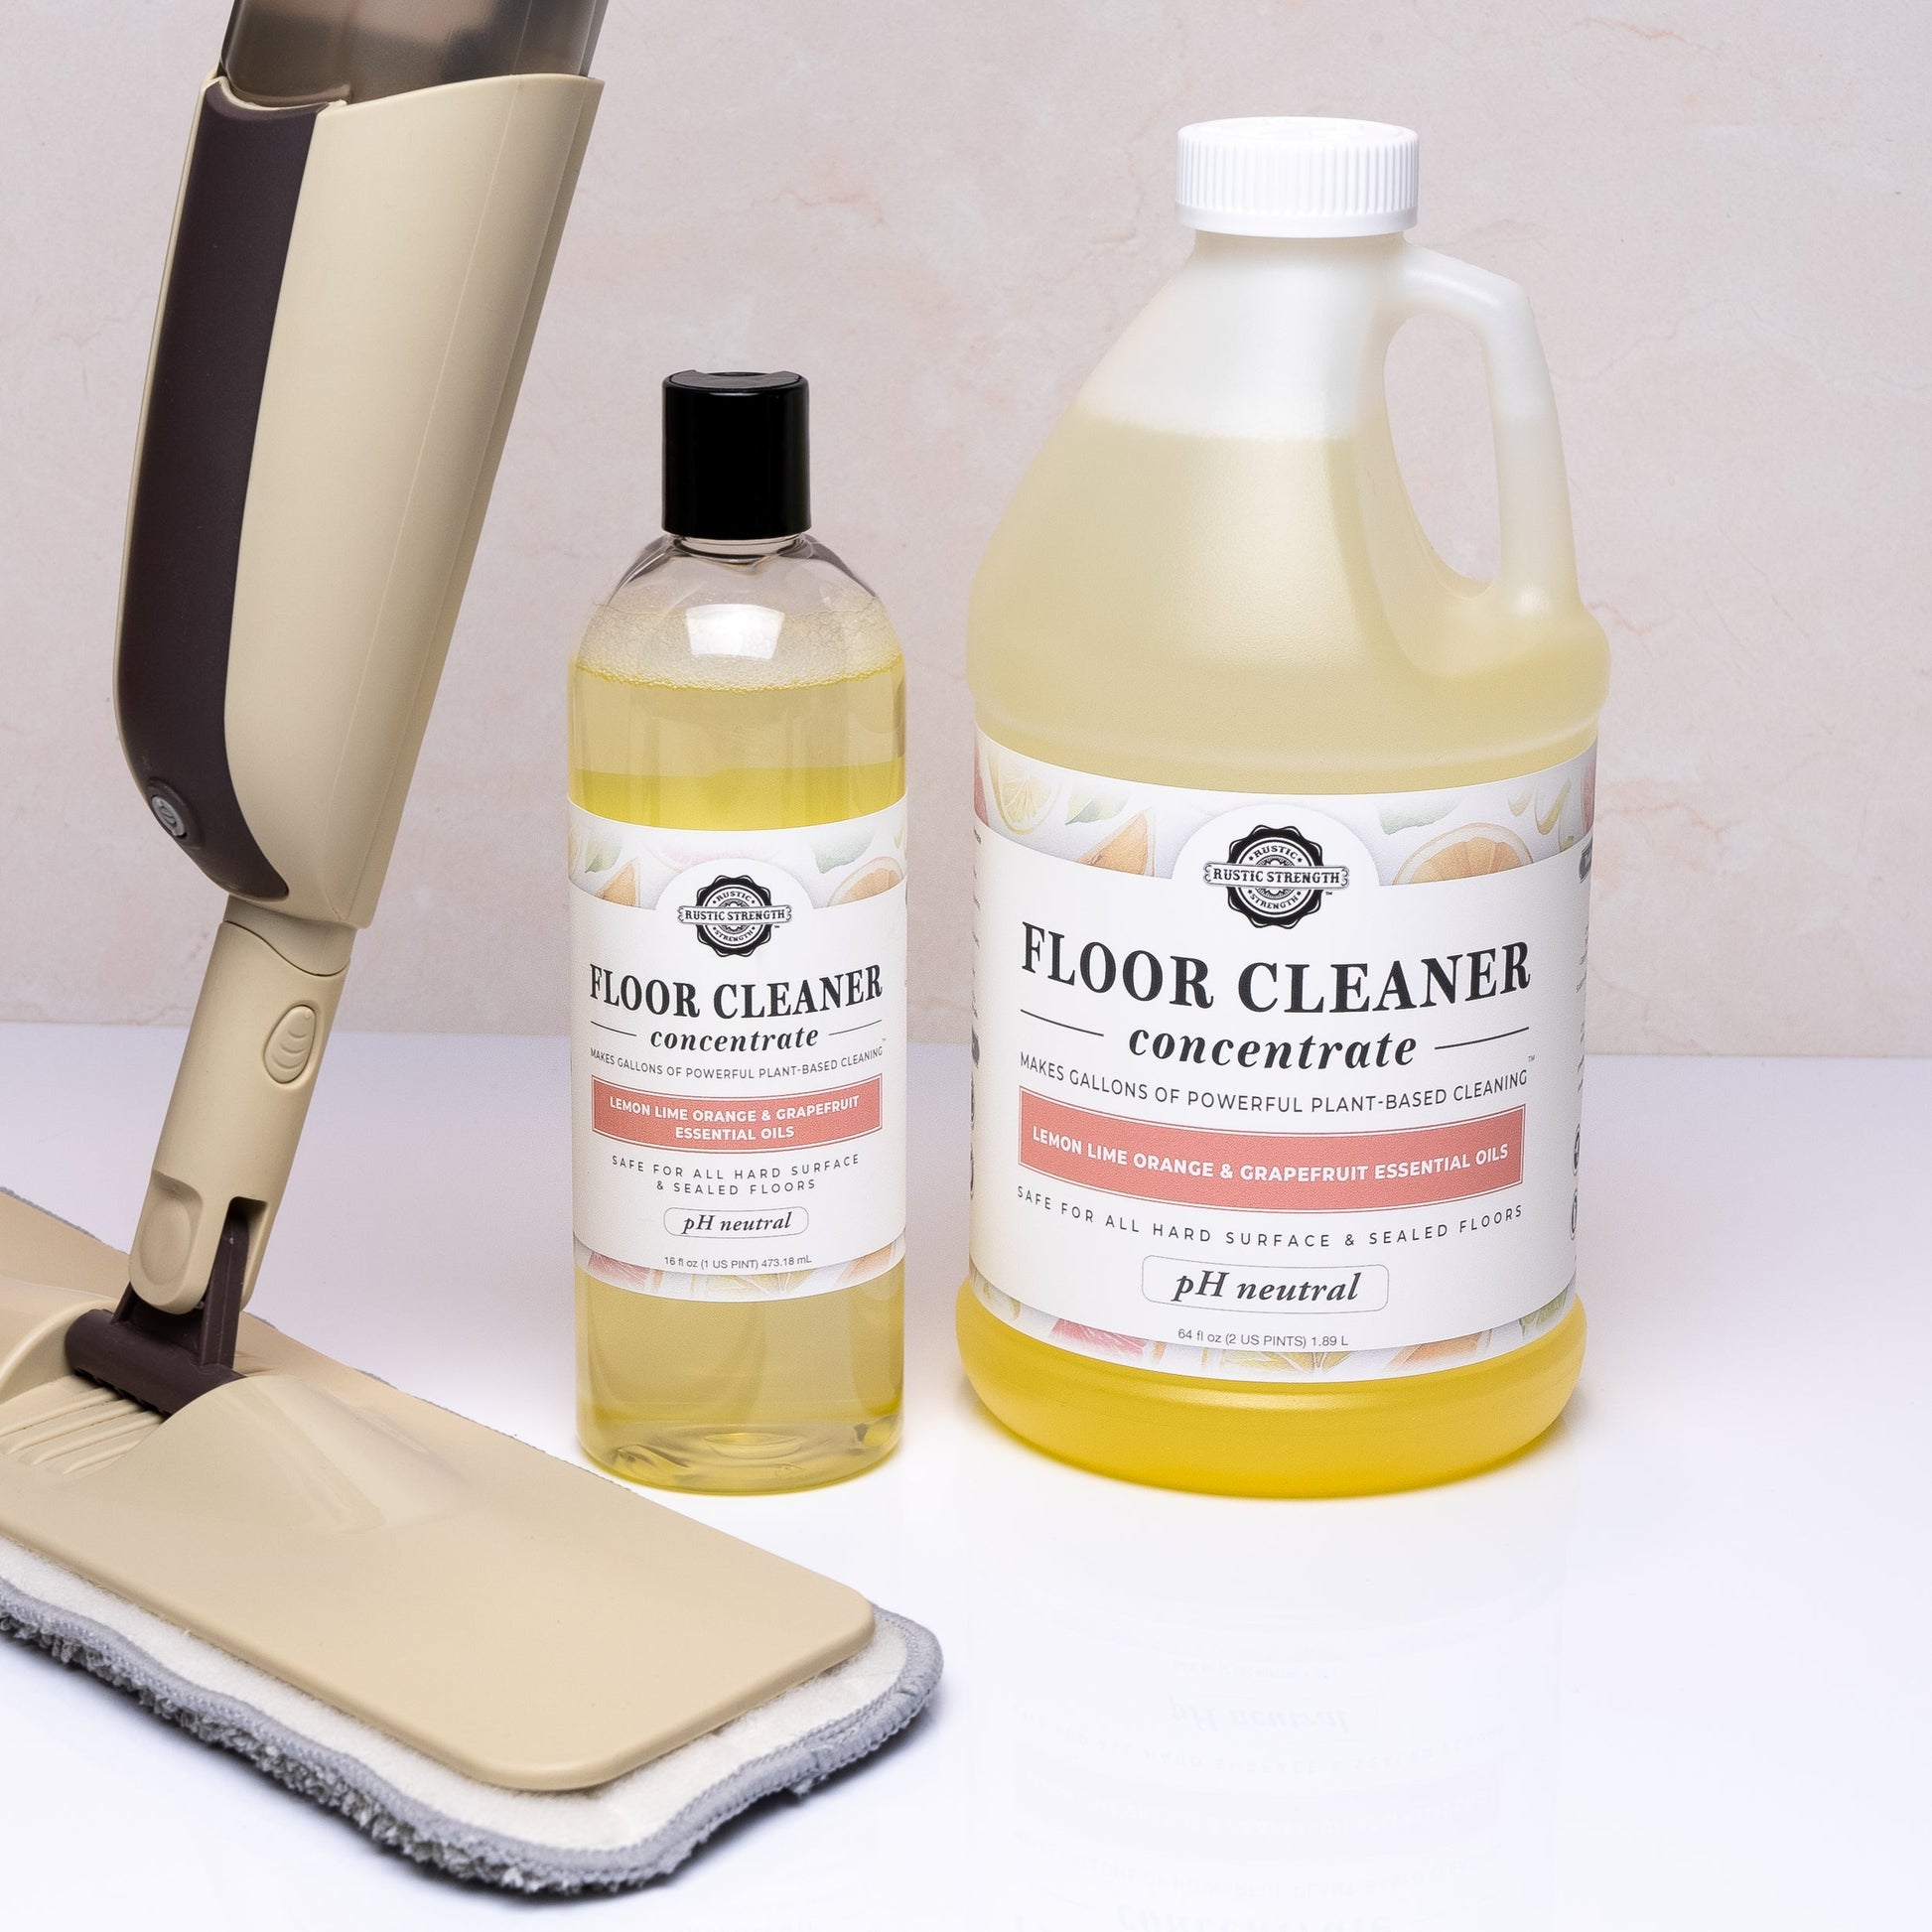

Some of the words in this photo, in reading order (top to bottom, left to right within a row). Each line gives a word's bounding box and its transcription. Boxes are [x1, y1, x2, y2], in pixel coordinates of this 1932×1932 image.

[1253, 845, 1298, 859] RUSTIC
[1213, 868, 1264, 882] RUSTIC
[1267, 871, 1339, 884] STRENGTH
[716, 891, 752, 901] RUSTIC
[1249, 894, 1298, 909] STRENGTH
[685, 909, 725, 921] RUSTIC
[727, 909, 785, 921] STRENGTH
[714, 929, 754, 942] STRENGTH
[1022, 921, 1213, 1009] FLOOR
[1238, 942, 1530, 1013] CLEANER
[590, 964, 700, 1018] FLOOR
[714, 965, 882, 1019] CLEANER
[650, 1028, 818, 1051] concentrate
[1130, 1030, 1416, 1069] concentrate
[591, 1048, 615, 1064] MAKES
[618, 1057, 662, 1074] GALLONS
[667, 1066, 681, 1076] OF
[686, 1068, 755, 1078] POWERFUL
[759, 1060, 837, 1077] PLANT-BASED
[841, 1046, 882, 1066] CLEANING
[1021, 1052, 1063, 1080] MAKES
[1070, 1069, 1147, 1099] GALLONS
[1156, 1087, 1179, 1103] OF
[1188, 1091, 1303, 1112] POWERFUL
[1312, 1089, 1447, 1112] PLANT-BASED
[1453, 1069, 1526, 1101] CLEANING
[611, 1096, 650, 1116] LEMON
[655, 1106, 688, 1120] LIME
[693, 1110, 757, 1122] ORANGE
[761, 1110, 770, 1121] &
[776, 1095, 859, 1120] GRAPEFRUIT
[676, 1127, 756, 1140] ESSENTIAL
[761, 1126, 794, 1139] OILS
[1034, 1126, 1081, 1155] LEMON
[1088, 1143, 1127, 1165] LIME
[1134, 1154, 1213, 1176] ORANGE
[1220, 1164, 1233, 1178] &
[1240, 1166, 1368, 1181] GRAPEFRUIT
[1375, 1154, 1470, 1178] ESSENTIAL
[1475, 1144, 1507, 1165] OILS
[613, 1156, 643, 1172] SAFE
[653, 1165, 682, 1176] FOR
[693, 1170, 723, 1178] ALL
[735, 1169, 779, 1178] HARD
[792, 1155, 858, 1175] SURFACE
[657, 1180, 663, 1189] &
[674, 1182, 738, 1194] SEALED
[751, 1179, 814, 1194] FLOORS
[681, 1215, 715, 1234] pH
[721, 1211, 791, 1231] neutral
[1018, 1186, 1050, 1209] SAFE
[1062, 1202, 1093, 1222] FOR
[1106, 1215, 1139, 1232] ALL
[1154, 1223, 1210, 1241] HARD
[1226, 1232, 1328, 1247] SURFACE
[1345, 1234, 1353, 1246] &
[1370, 1224, 1447, 1244] SEALED
[1460, 1205, 1521, 1232] FLOORS
[701, 1260, 708, 1270] (1
[713, 1260, 728, 1269] US
[732, 1260, 758, 1269] PINT)
[761, 1257, 794, 1267] 473.18
[797, 1255, 812, 1264] mL
[1172, 1271, 1229, 1302] pH
[1237, 1273, 1361, 1301] neutral
[1178, 1328, 1191, 1339] 64
[1197, 1330, 1203, 1340] fl
[1226, 1333, 1236, 1345] (2
[1241, 1334, 1259, 1345] US
[1263, 1335, 1306, 1347] PINTS)
[1311, 1336, 1336, 1346] 1.89
[1341, 1335, 1348, 1345] L
